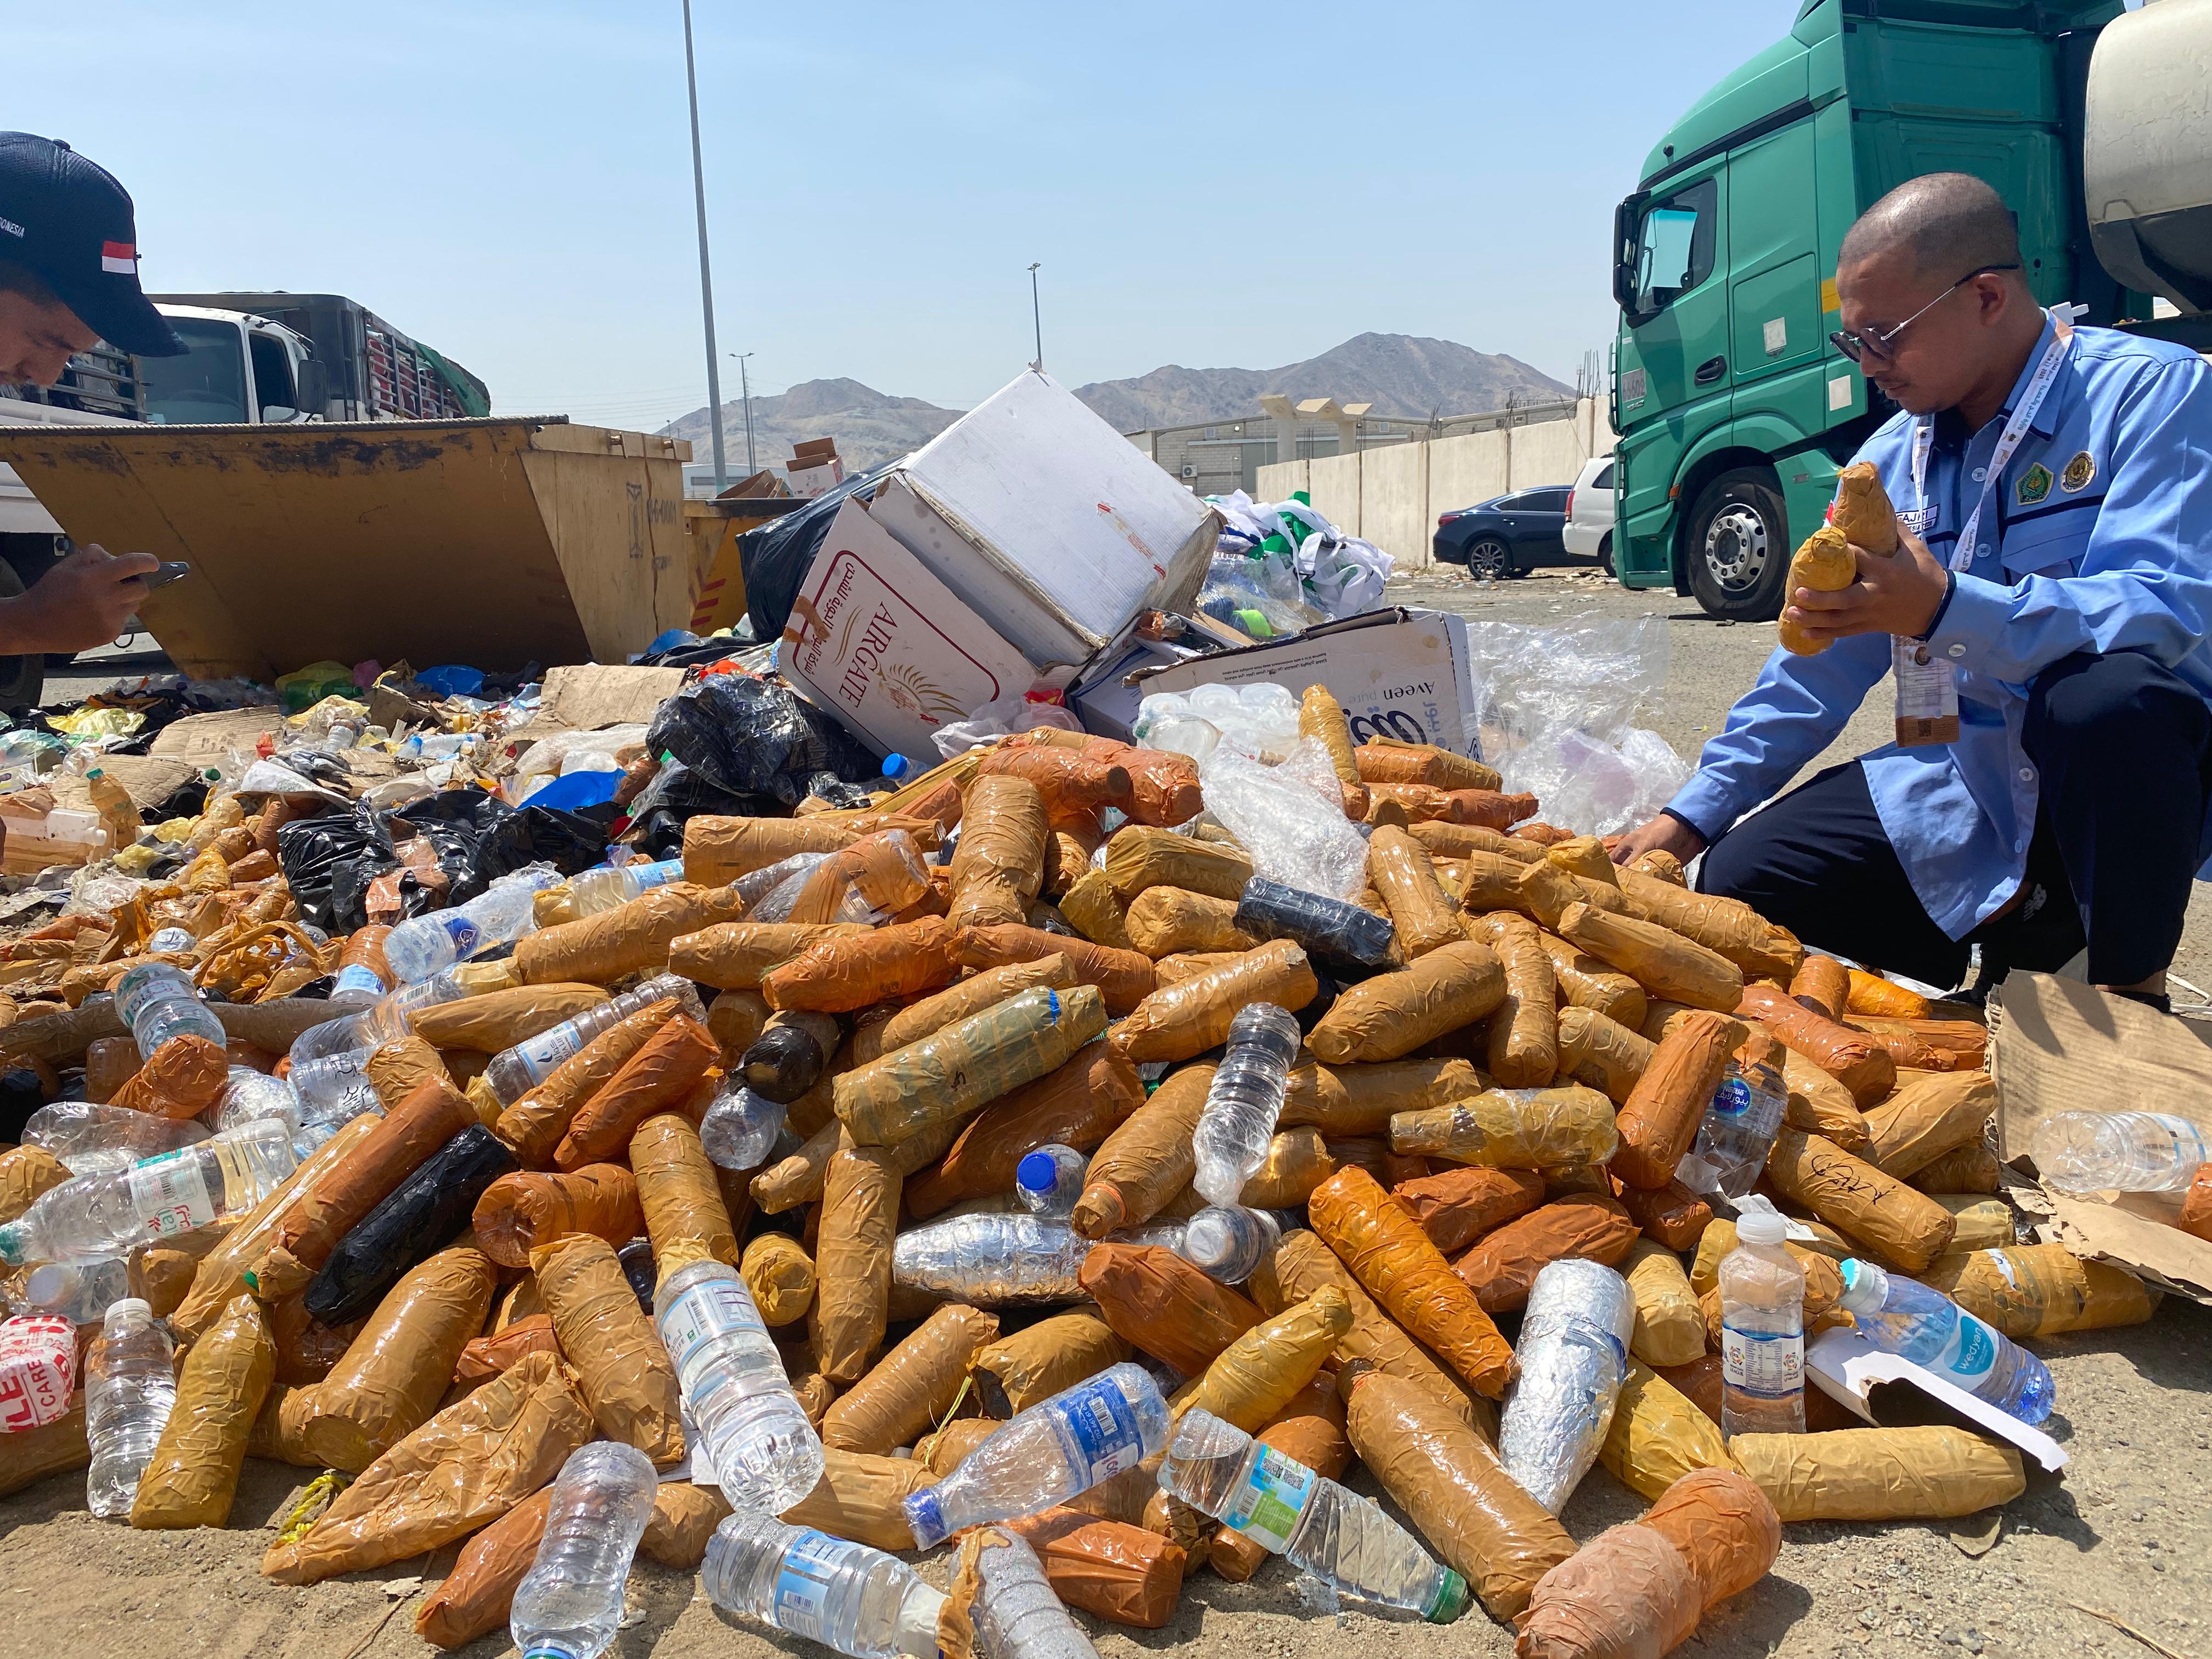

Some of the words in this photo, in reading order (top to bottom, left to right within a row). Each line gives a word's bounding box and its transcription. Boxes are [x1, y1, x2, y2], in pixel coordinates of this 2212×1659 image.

[836, 562, 855, 601] للشحن
[839, 601, 898, 708] AIRGATE
[1348, 689, 1377, 704] pure
[1383, 681, 1435, 700] Aveen
[1958, 1327, 1983, 1370] wedyan
[27, 1359, 56, 1407] CARE
